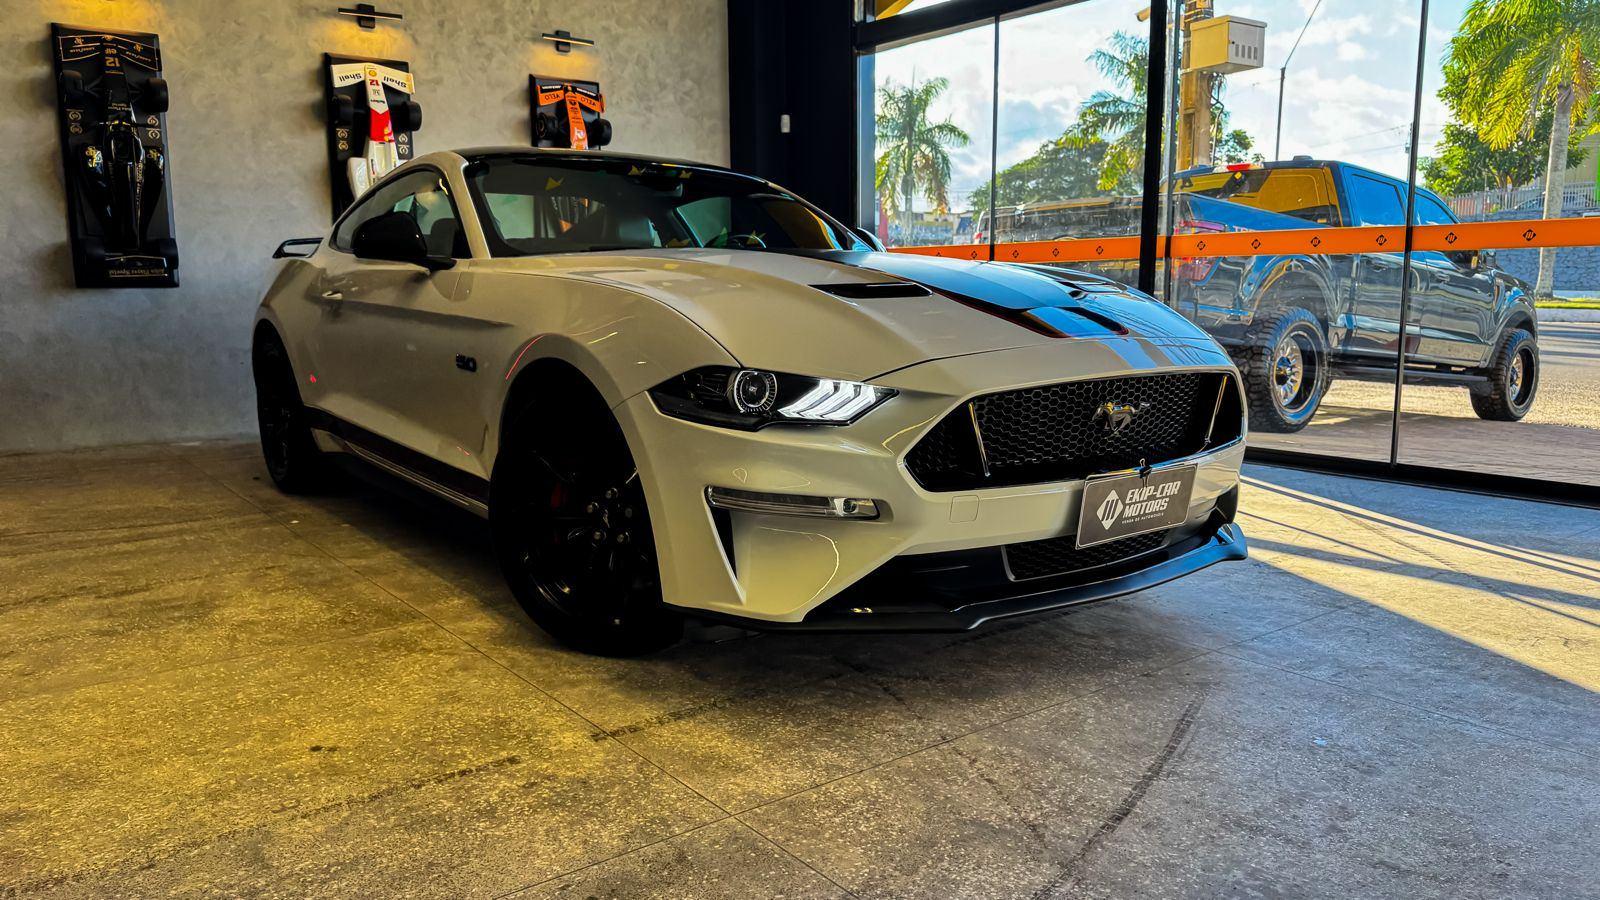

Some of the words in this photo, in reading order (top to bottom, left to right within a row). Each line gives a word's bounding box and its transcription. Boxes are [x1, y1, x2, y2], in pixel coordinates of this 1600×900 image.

[105, 57, 121, 67] 12
[339, 73, 362, 82] Shell
[368, 79, 380, 87] 12
[383, 76, 407, 88] Shell
[1125, 481, 1181, 504] EKIP-CAR
[1122, 498, 1169, 518] MOTORS
